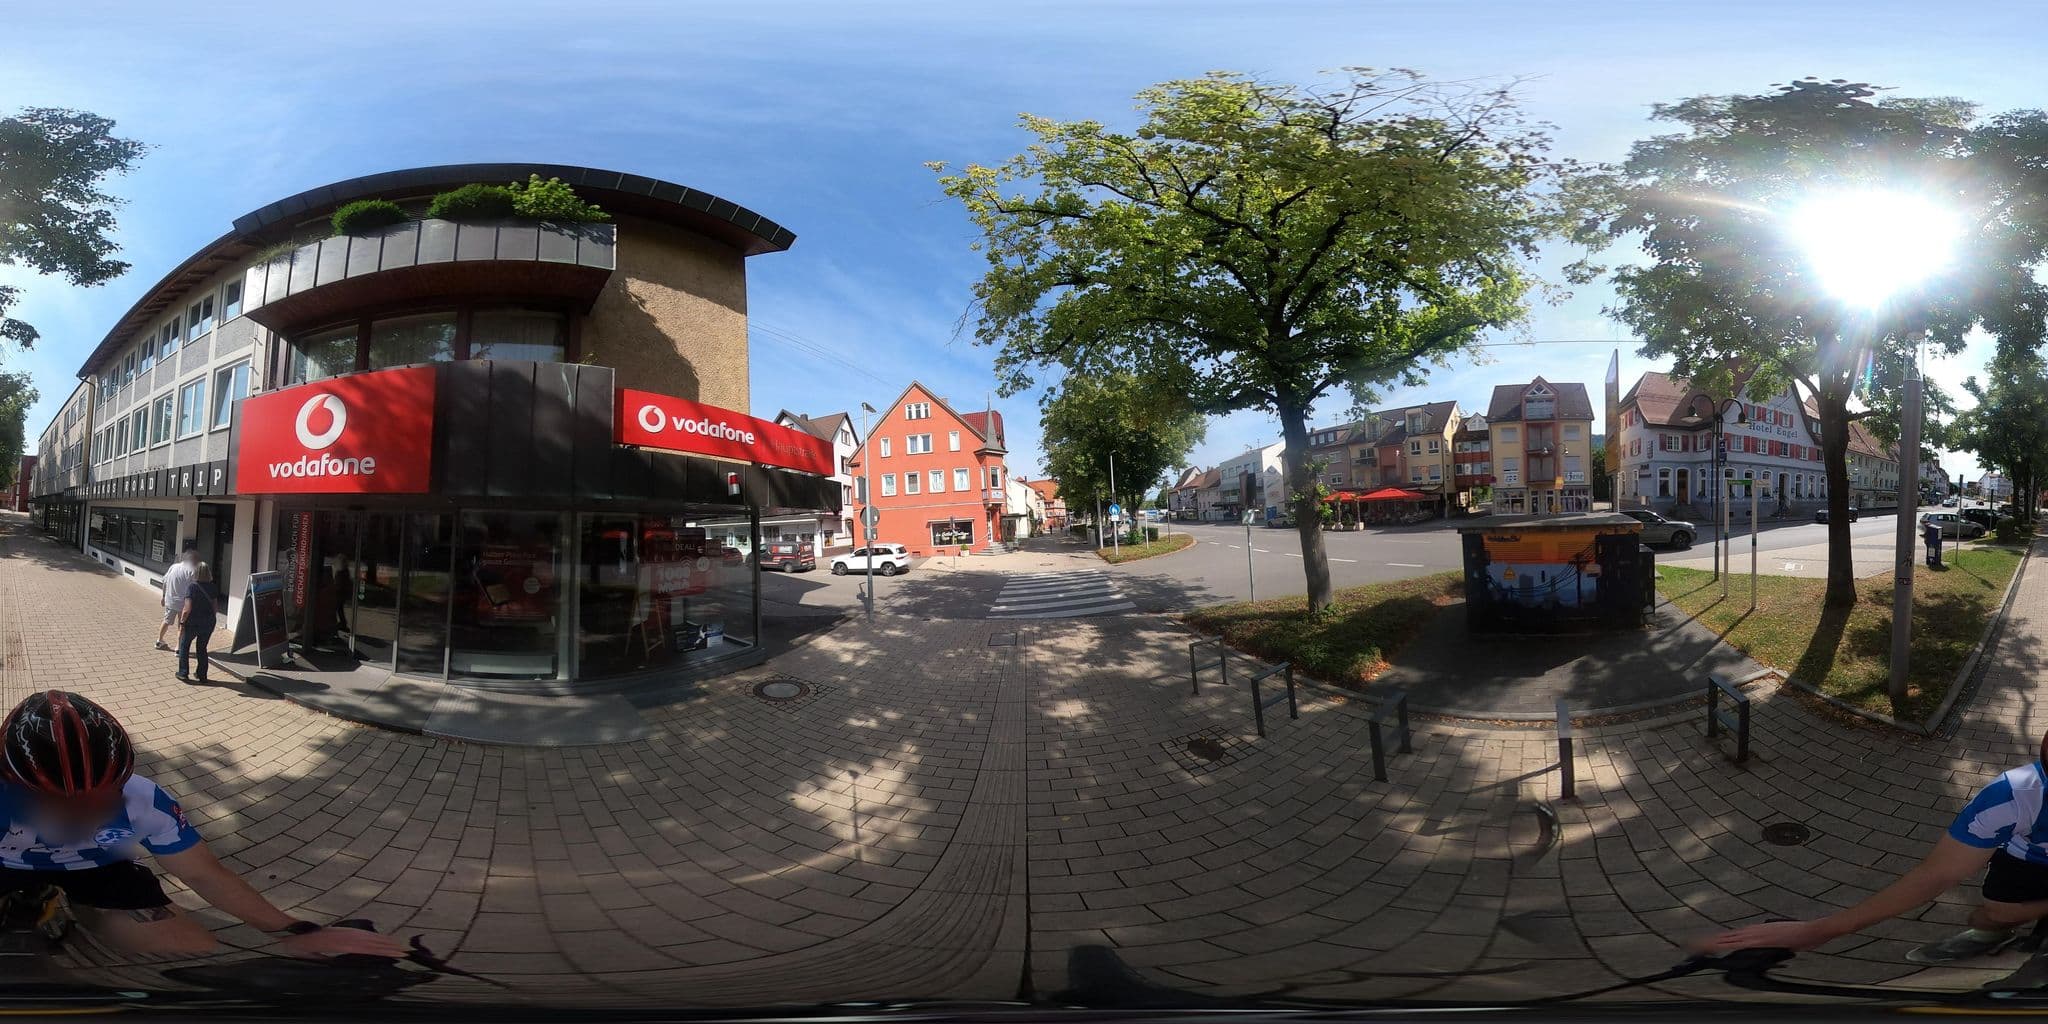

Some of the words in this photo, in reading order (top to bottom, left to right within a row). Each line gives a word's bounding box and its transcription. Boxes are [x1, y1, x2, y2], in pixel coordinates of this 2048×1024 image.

[672, 416, 755, 445] vodafone
[1749, 422, 1772, 434] Hotel
[1776, 427, 1798, 440] Engel
[269, 453, 376, 478] vodafone
[124, 477, 154, 493] ROAD
[170, 468, 222, 489] TRIP
